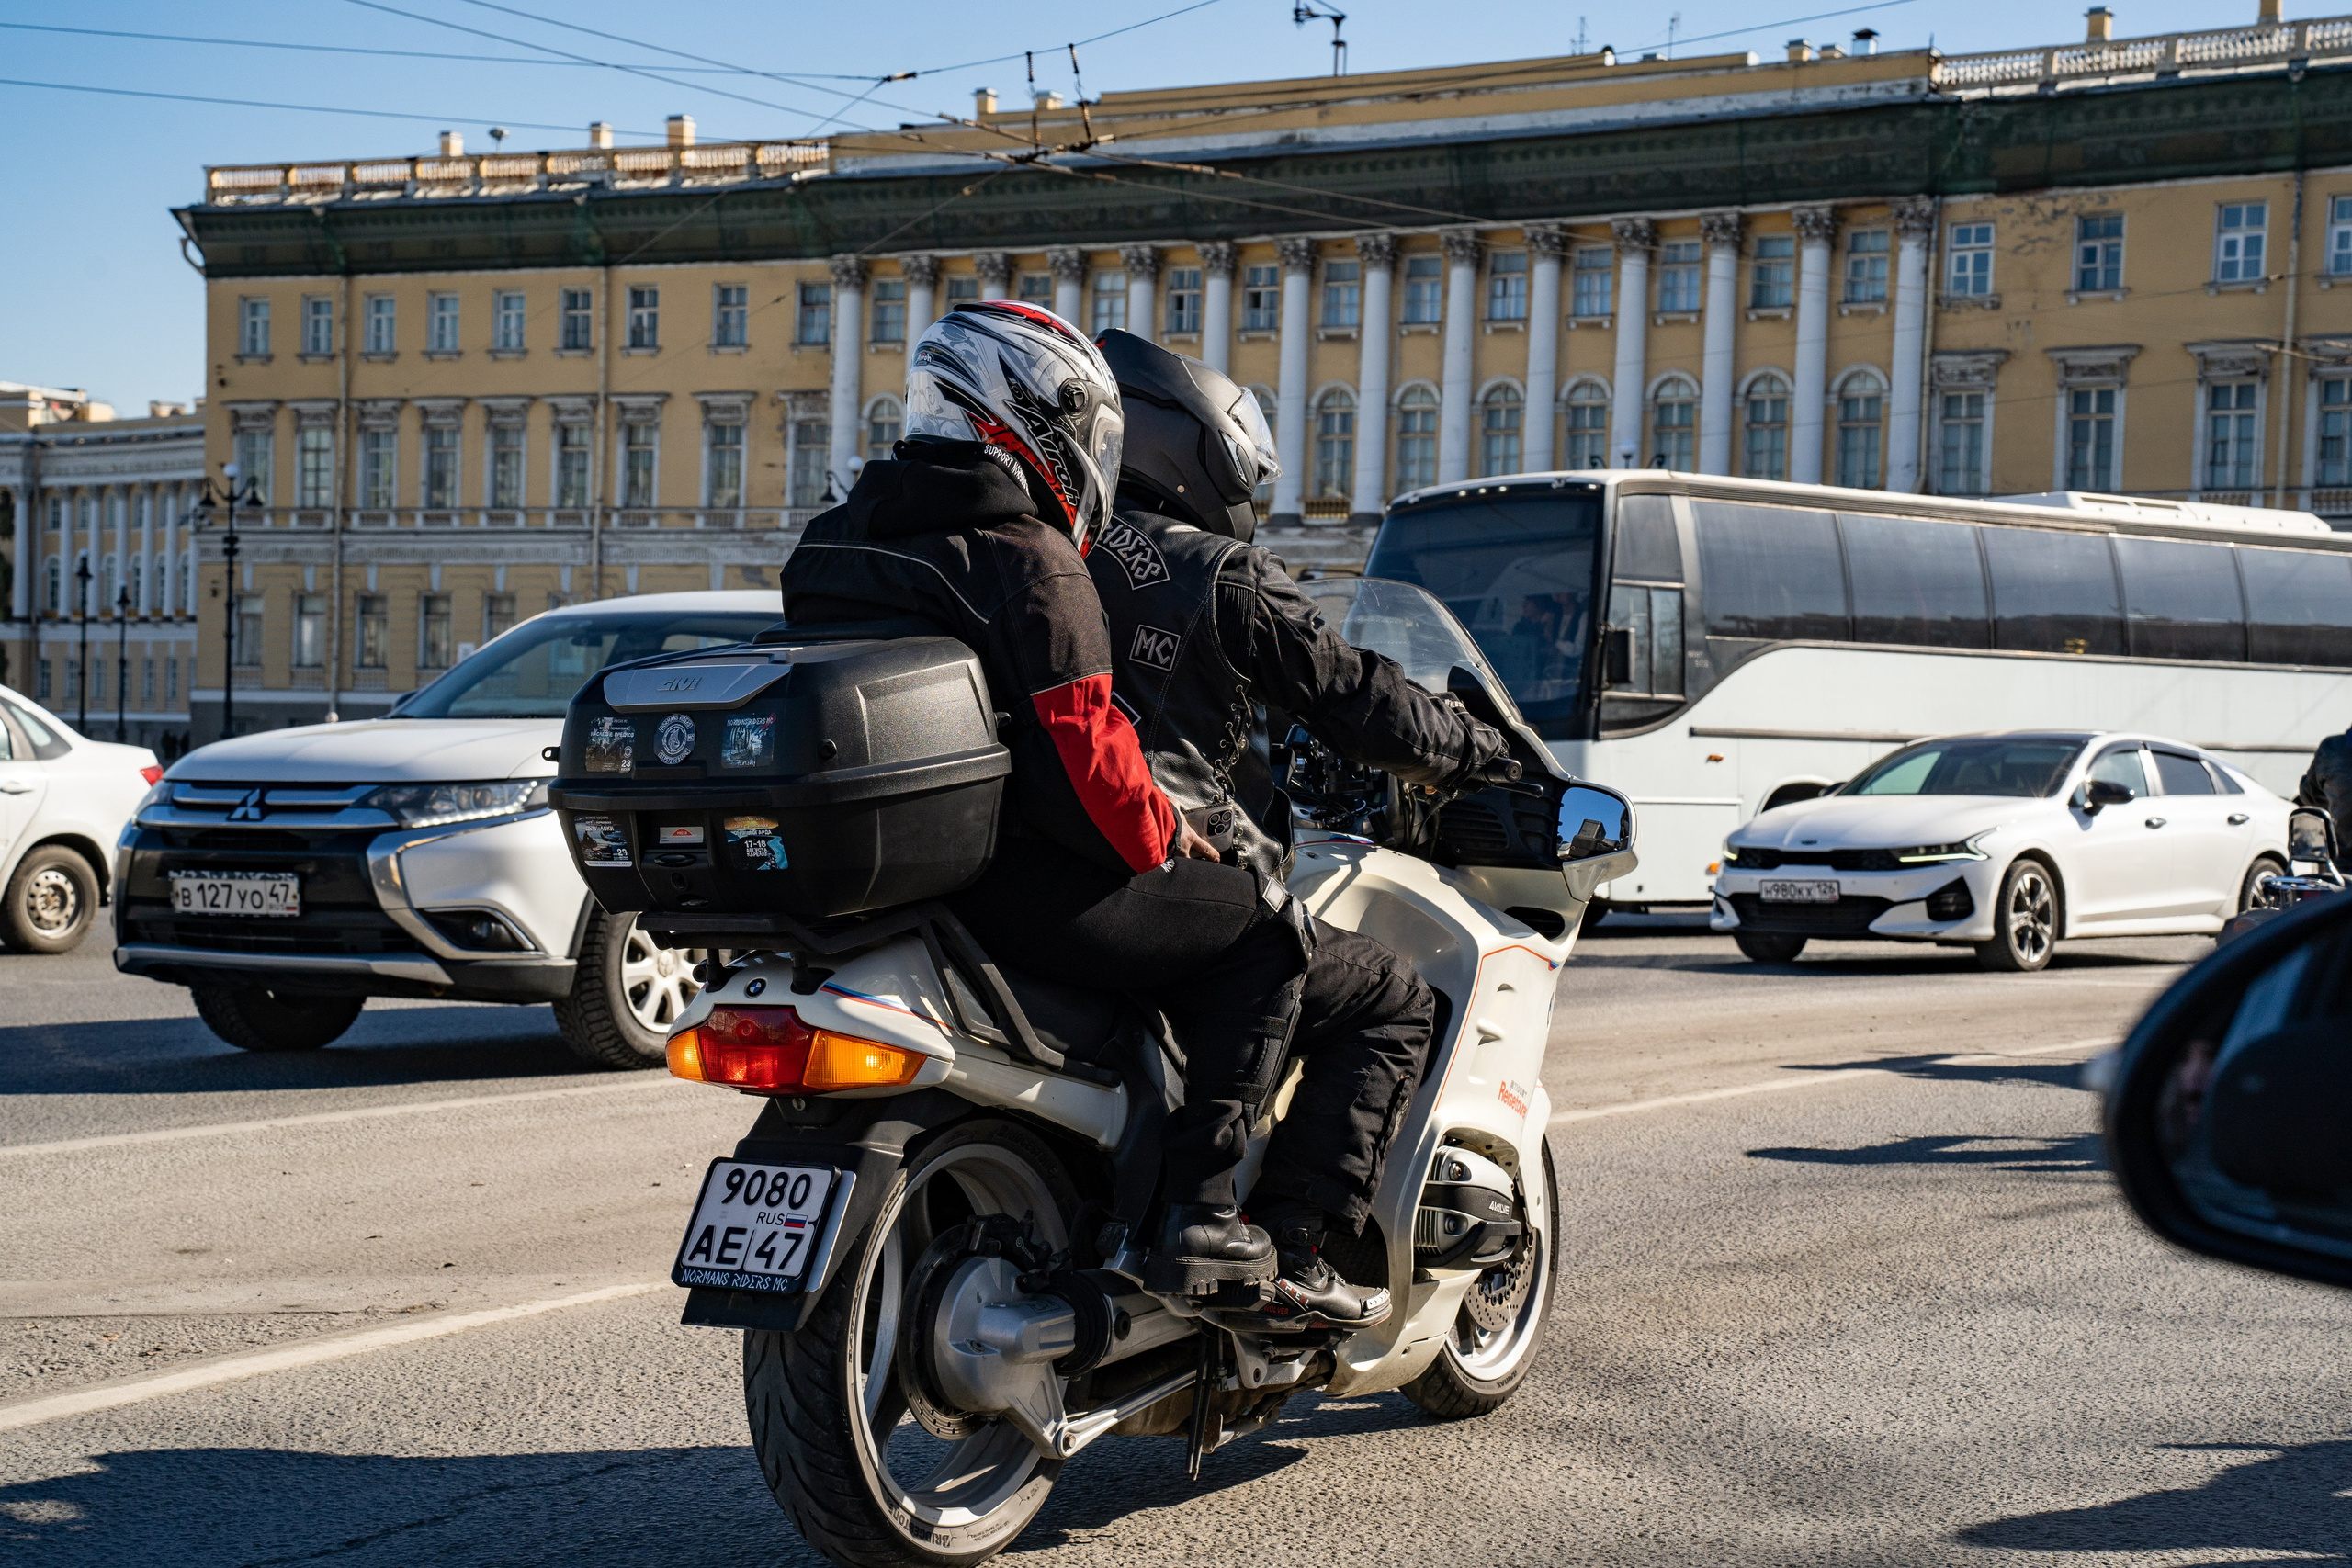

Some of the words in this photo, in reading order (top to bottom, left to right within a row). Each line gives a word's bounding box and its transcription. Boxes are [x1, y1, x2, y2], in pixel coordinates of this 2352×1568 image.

[983, 444, 1014, 468] SUPPORT
[1002, 399, 1080, 507] Airoh
[1134, 628, 1174, 665] MC
[621, 759, 631, 768] 23
[744, 840, 767, 849] 17-18
[269, 883, 290, 904] 47
[721, 1168, 812, 1210] 9080
[755, 1211, 785, 1226] RUS
[754, 1230, 805, 1270] 47
[681, 1269, 730, 1286] NORMANS
[731, 1272, 772, 1291] RIDERS
[772, 1275, 789, 1292] MC
[887, 1502, 952, 1549] BRIDGESTONE
